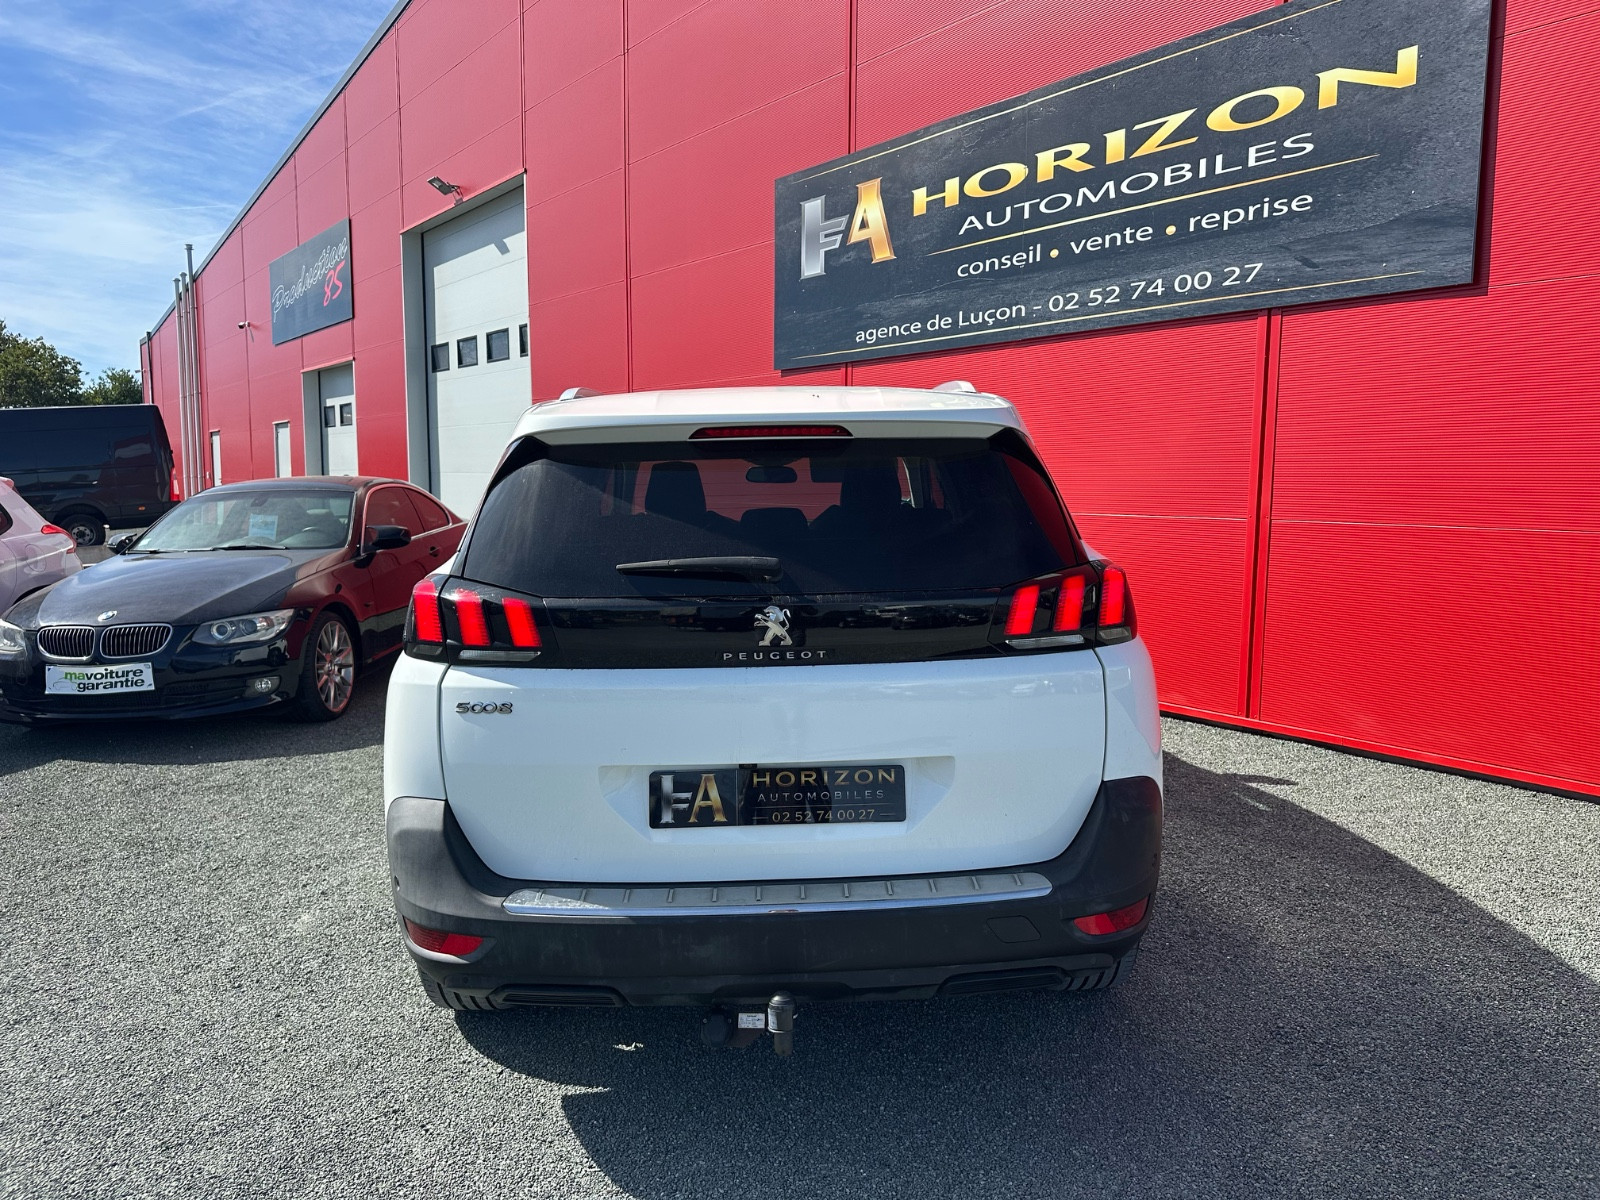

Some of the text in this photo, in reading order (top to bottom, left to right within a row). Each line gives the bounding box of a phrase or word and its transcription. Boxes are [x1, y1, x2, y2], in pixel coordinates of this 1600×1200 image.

[912, 45, 1419, 216] HORIZON
[958, 133, 1315, 235] AUTOMOBILES
[957, 194, 1314, 277] conseil vente reprise
[323, 260, 346, 307] 85
[855, 321, 921, 344] agence
[926, 314, 953, 332] de
[958, 303, 1026, 327] Luçon
[1048, 292, 1080, 312] 02
[1087, 285, 1121, 307] 52
[1129, 278, 1165, 300] 74
[1174, 271, 1213, 292] 00
[1222, 262, 1264, 286] 27
[723, 650, 826, 660] PEUGEOT
[77, 677, 145, 692] garantie
[455, 701, 513, 714] 5008
[752, 768, 896, 788] HORIZON
[757, 790, 885, 803] AUTOMOBILES
[772, 809, 875, 823] 02 52 74 00 27
